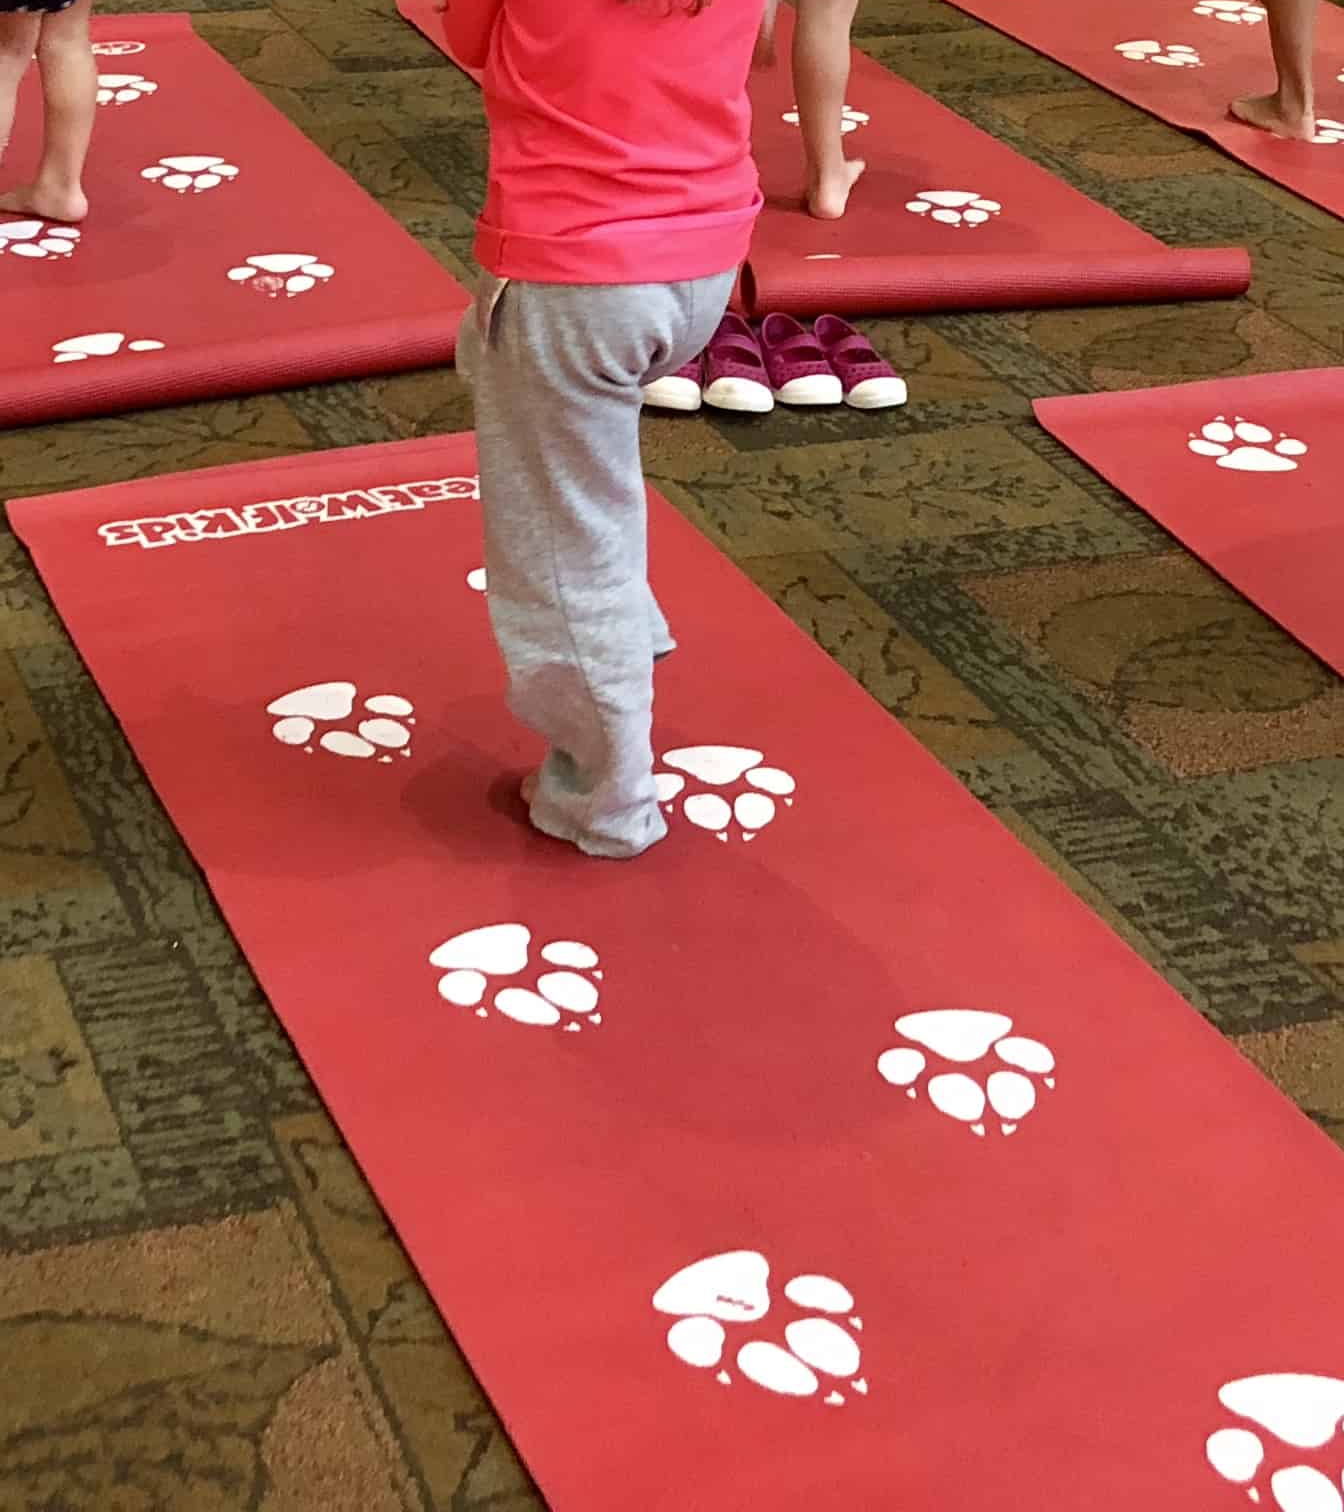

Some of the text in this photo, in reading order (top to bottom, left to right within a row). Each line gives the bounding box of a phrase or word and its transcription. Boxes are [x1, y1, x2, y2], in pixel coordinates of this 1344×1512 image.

[97, 475, 481, 550] eat Wolf Kids
